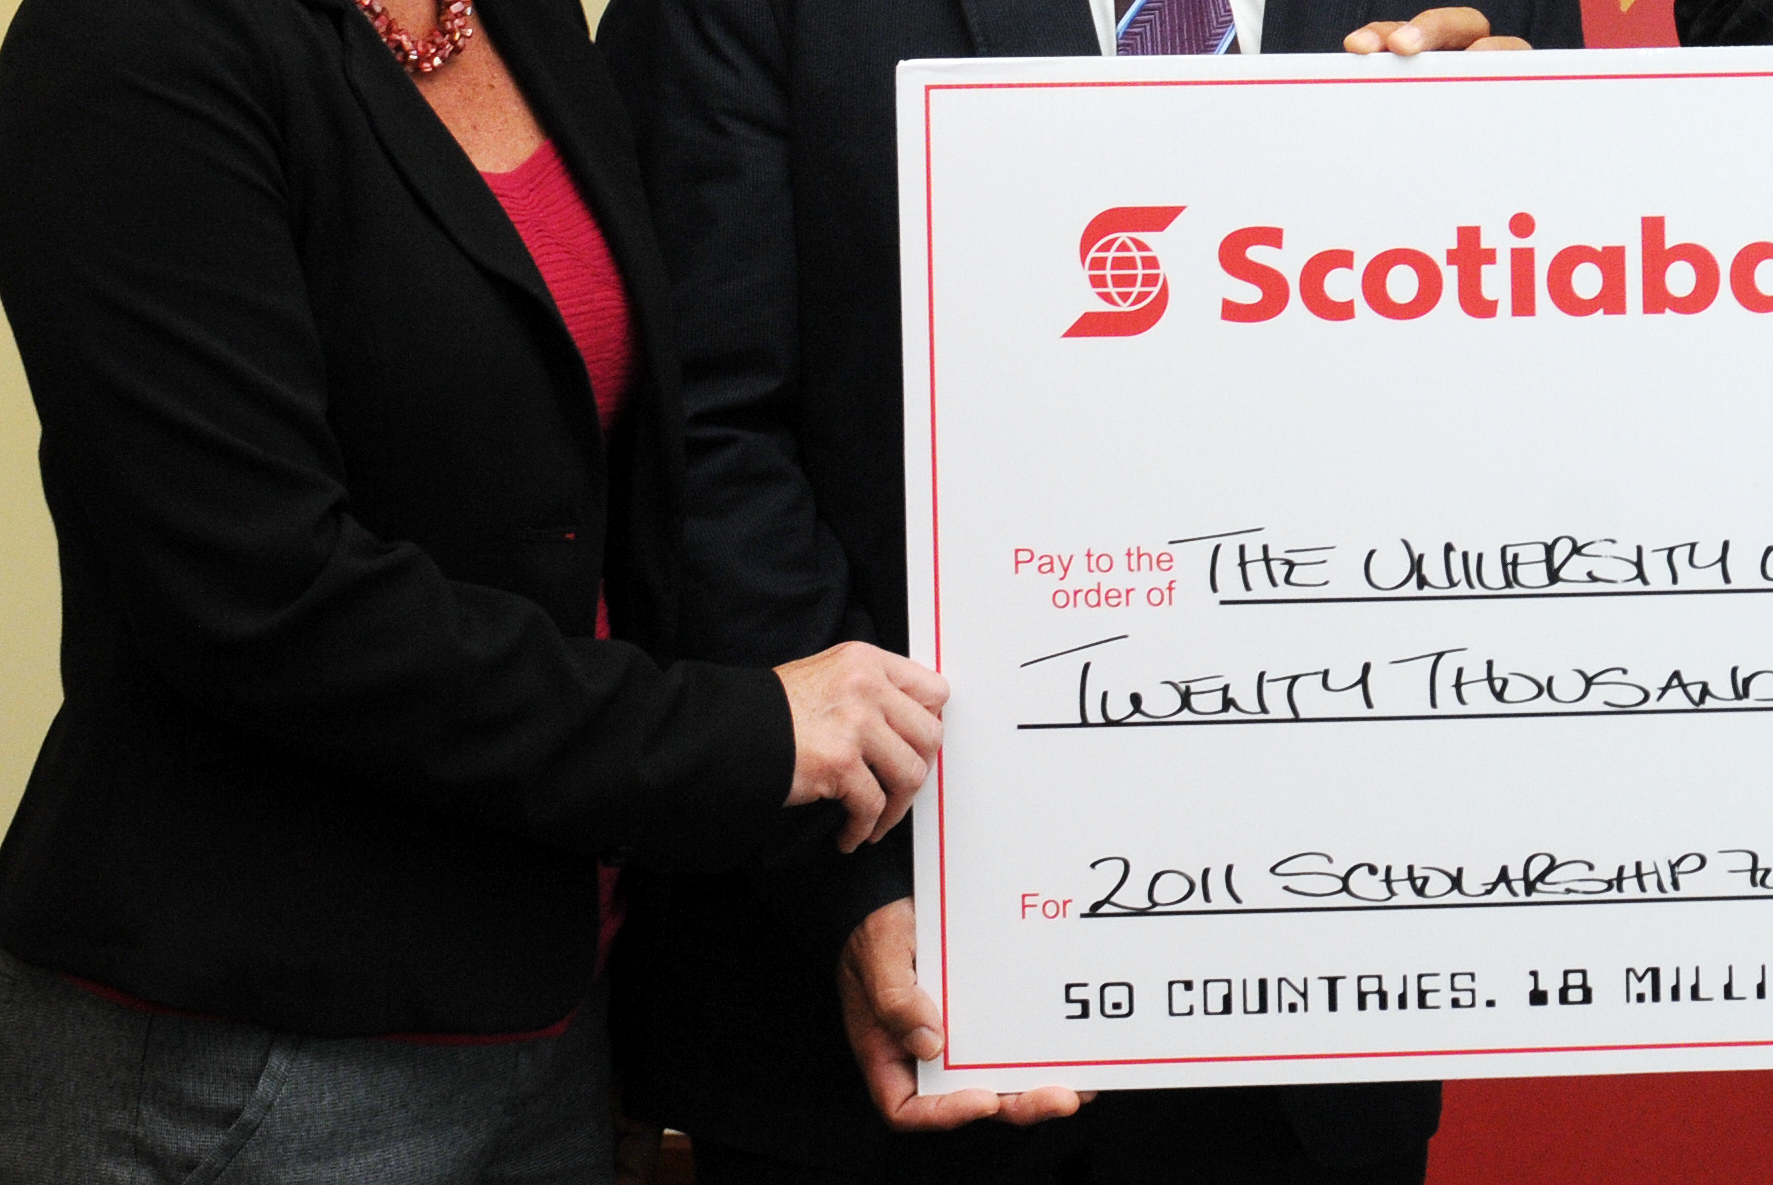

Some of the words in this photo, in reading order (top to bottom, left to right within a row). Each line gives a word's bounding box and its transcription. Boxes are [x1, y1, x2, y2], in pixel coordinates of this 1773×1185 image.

[1014, 547, 1073, 581] Pay
[1085, 548, 1114, 573] to
[1125, 546, 1174, 573] the
[1169, 528, 1334, 593] THE
[1364, 536, 1731, 591] UNIVERSITY
[1052, 578, 1134, 609] order
[1144, 579, 1177, 607] of
[1020, 635, 1373, 724] TWENTY
[1021, 892, 1073, 920] For
[1089, 857, 1243, 914] 2011
[1269, 851, 1707, 901] SCHOLARSHIP
[1064, 981, 1135, 1020] 50
[1167, 971, 1497, 1018] COUNTRIES.
[1528, 968, 1593, 1007] 18
